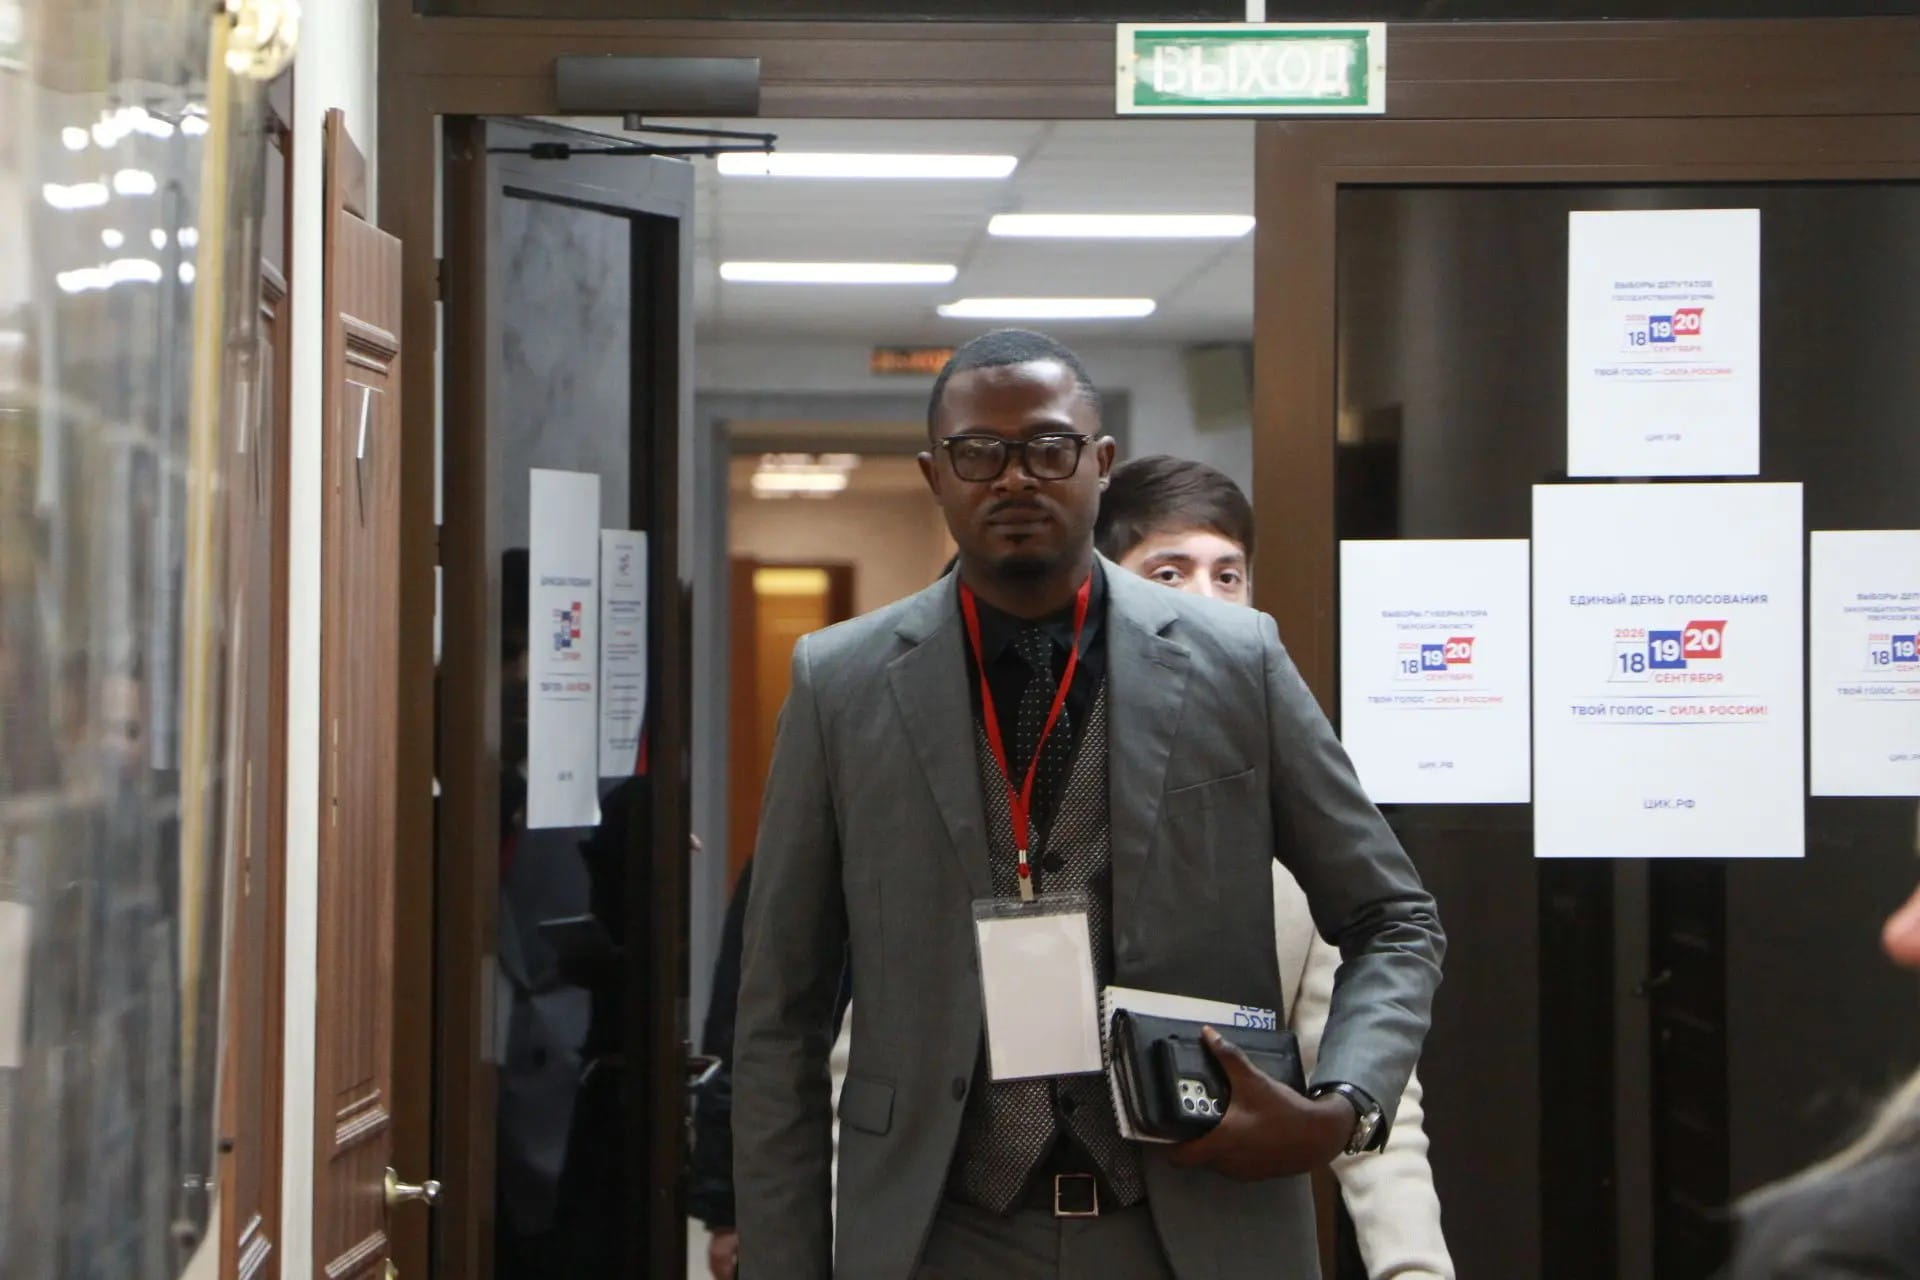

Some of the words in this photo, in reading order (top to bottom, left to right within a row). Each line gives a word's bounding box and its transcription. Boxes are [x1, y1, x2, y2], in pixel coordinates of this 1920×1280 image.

[1153, 45, 1350, 97] ВЫХОД
[1628, 331, 1647, 346] 18
[1650, 322, 1671, 338] 19
[1674, 313, 1699, 331] 20
[1570, 593, 1626, 606] ЕДИНЫЙ
[1630, 595, 1665, 606] ДЕНЬ
[1668, 594, 1769, 605] ГОЛОСОВАНИЯ
[1615, 628, 1645, 638] 2026
[1401, 660, 1419, 674] 18
[1422, 650, 1443, 666] 19
[1446, 642, 1470, 659] 20
[1619, 652, 1645, 673] 18
[1650, 639, 1681, 662] 19
[1685, 628, 1720, 651] 20
[1871, 650, 1889, 665] 18
[1894, 640, 1915, 657] 19
[1655, 673, 1724, 683] СЕНТЯБРЯ
[1571, 704, 1606, 715] ТВОЙ
[1610, 705, 1654, 715] ГОЛОС
[1669, 705, 1704, 715] СИЛА
[1709, 705, 1769, 715] РОССИИ!
[1644, 799, 1696, 809] ЦИК.РФ
